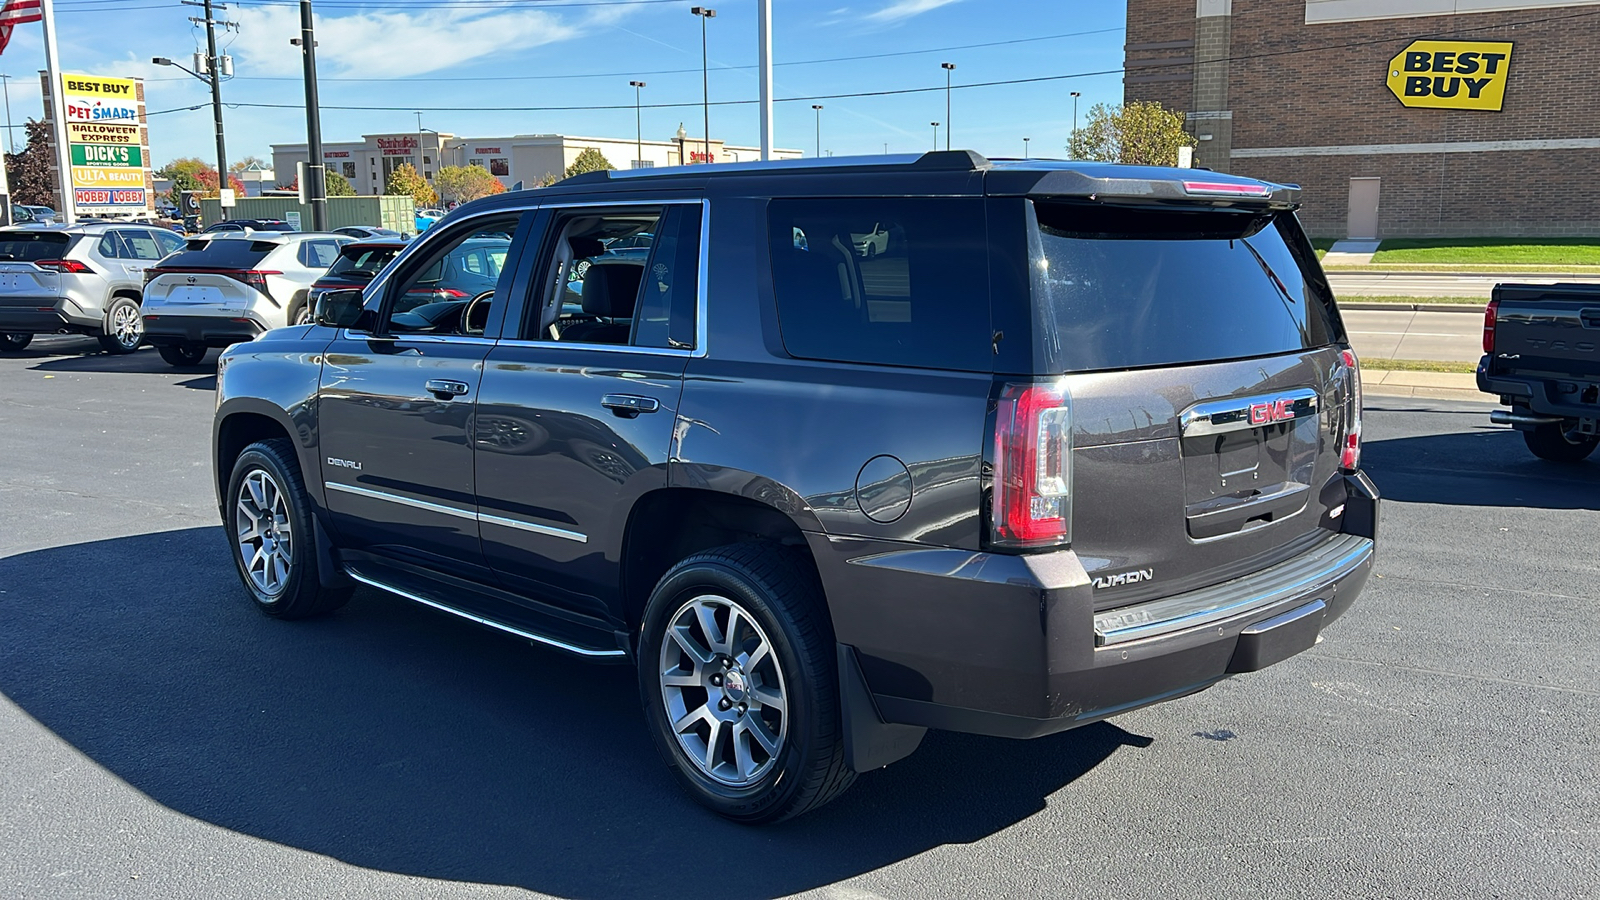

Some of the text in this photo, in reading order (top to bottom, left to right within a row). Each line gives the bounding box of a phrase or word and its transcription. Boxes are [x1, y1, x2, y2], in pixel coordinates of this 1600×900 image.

[1404, 52, 1506, 74] BEST
[67, 80, 130, 94] BEST BUY
[1404, 76, 1493, 99] BUY
[68, 104, 136, 121] PETSMART
[72, 124, 137, 134] HALLOWEEN
[81, 133, 130, 142] EXPRESS
[84, 145, 129, 162] DICK'S
[76, 169, 142, 182] ULTA BEAUTY
[75, 190, 143, 203] HOBBY LOBBY
[1249, 399, 1295, 424] GMC
[327, 457, 362, 470] DENALI
